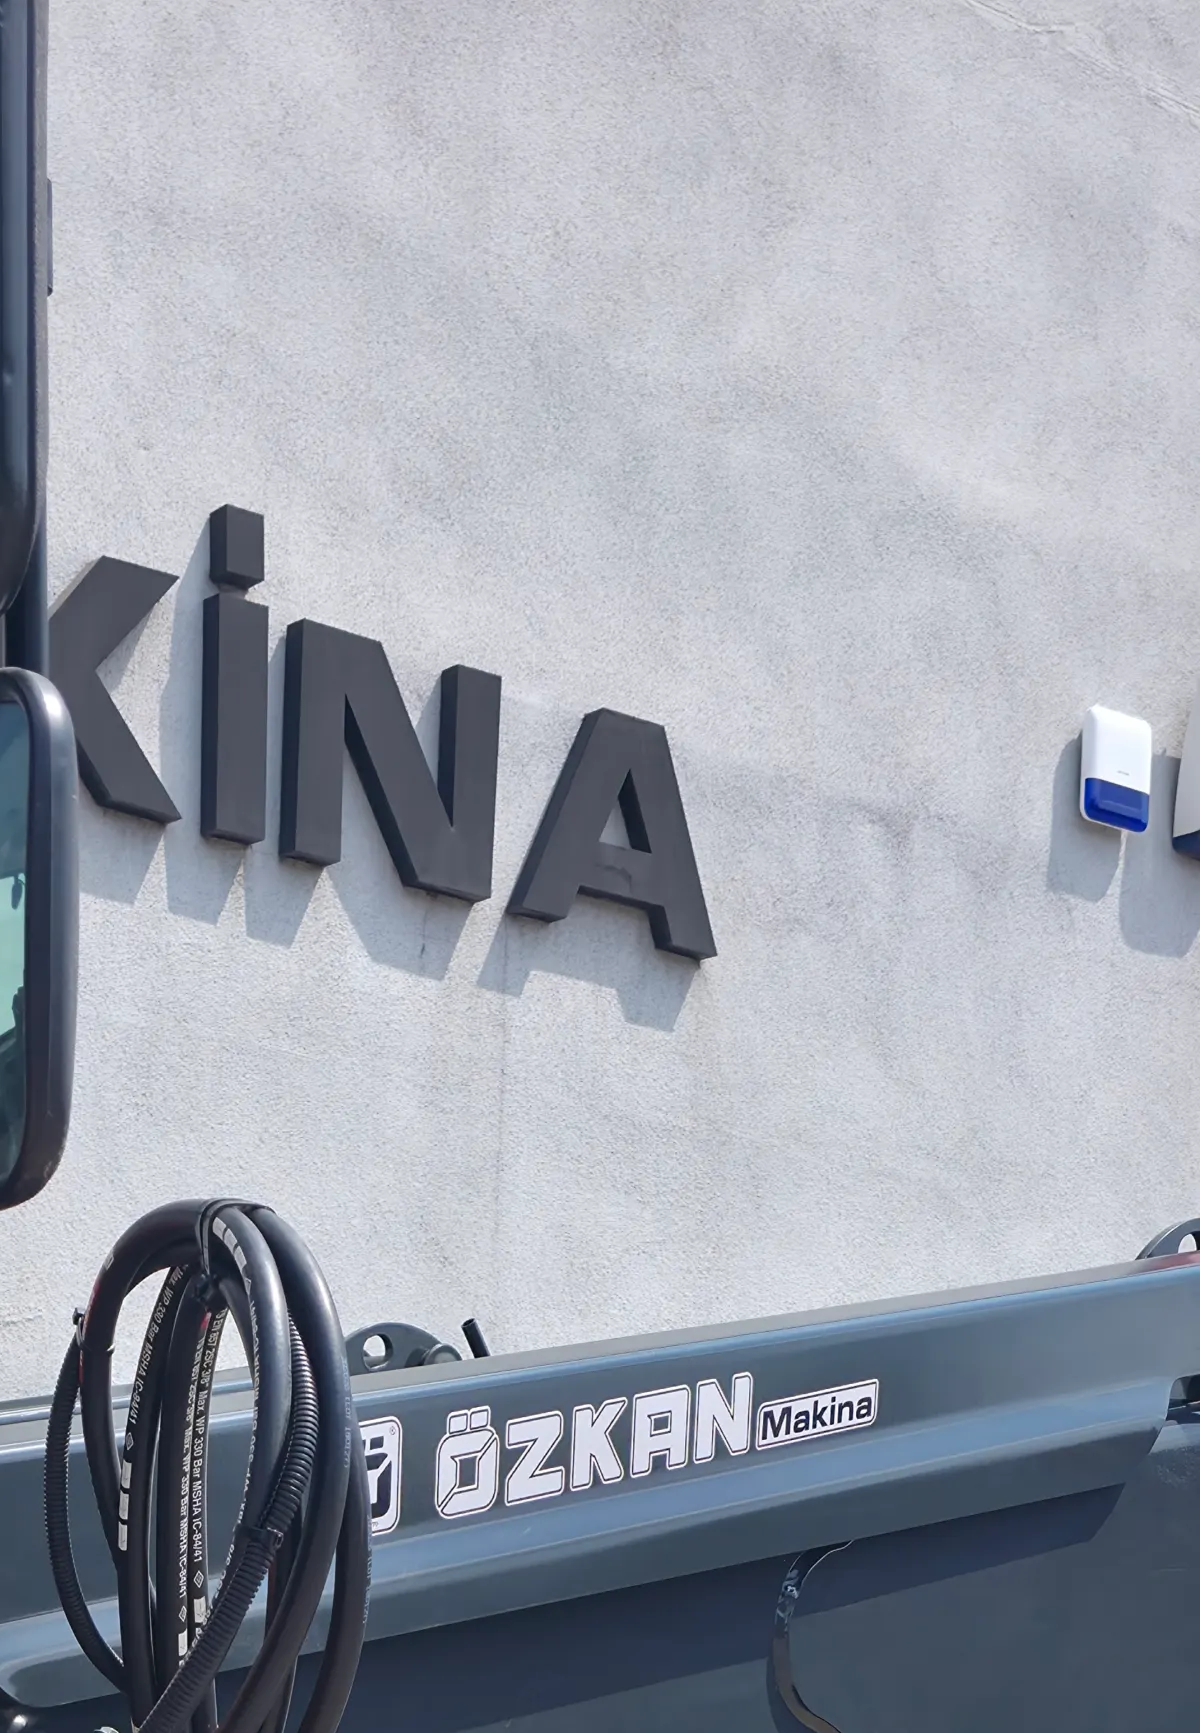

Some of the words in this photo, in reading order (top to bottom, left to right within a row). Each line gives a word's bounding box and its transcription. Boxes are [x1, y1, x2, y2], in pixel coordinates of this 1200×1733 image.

[161, 1285, 174, 1304] WP
[153, 1302, 167, 1323] 330
[145, 1322, 159, 1342] Bar
[138, 1343, 154, 1377] MSHA
[202, 1349, 215, 1368] 2SC
[196, 1391, 208, 1414] Max.
[196, 1416, 206, 1434] WP
[193, 1437, 204, 1456] 330
[437, 1373, 753, 1518] ÖZKAN
[761, 1394, 873, 1441] Makina
[192, 1459, 203, 1478] Bar
[191, 1481, 203, 1516] MSHA
[192, 1518, 202, 1563] IC-84/41
